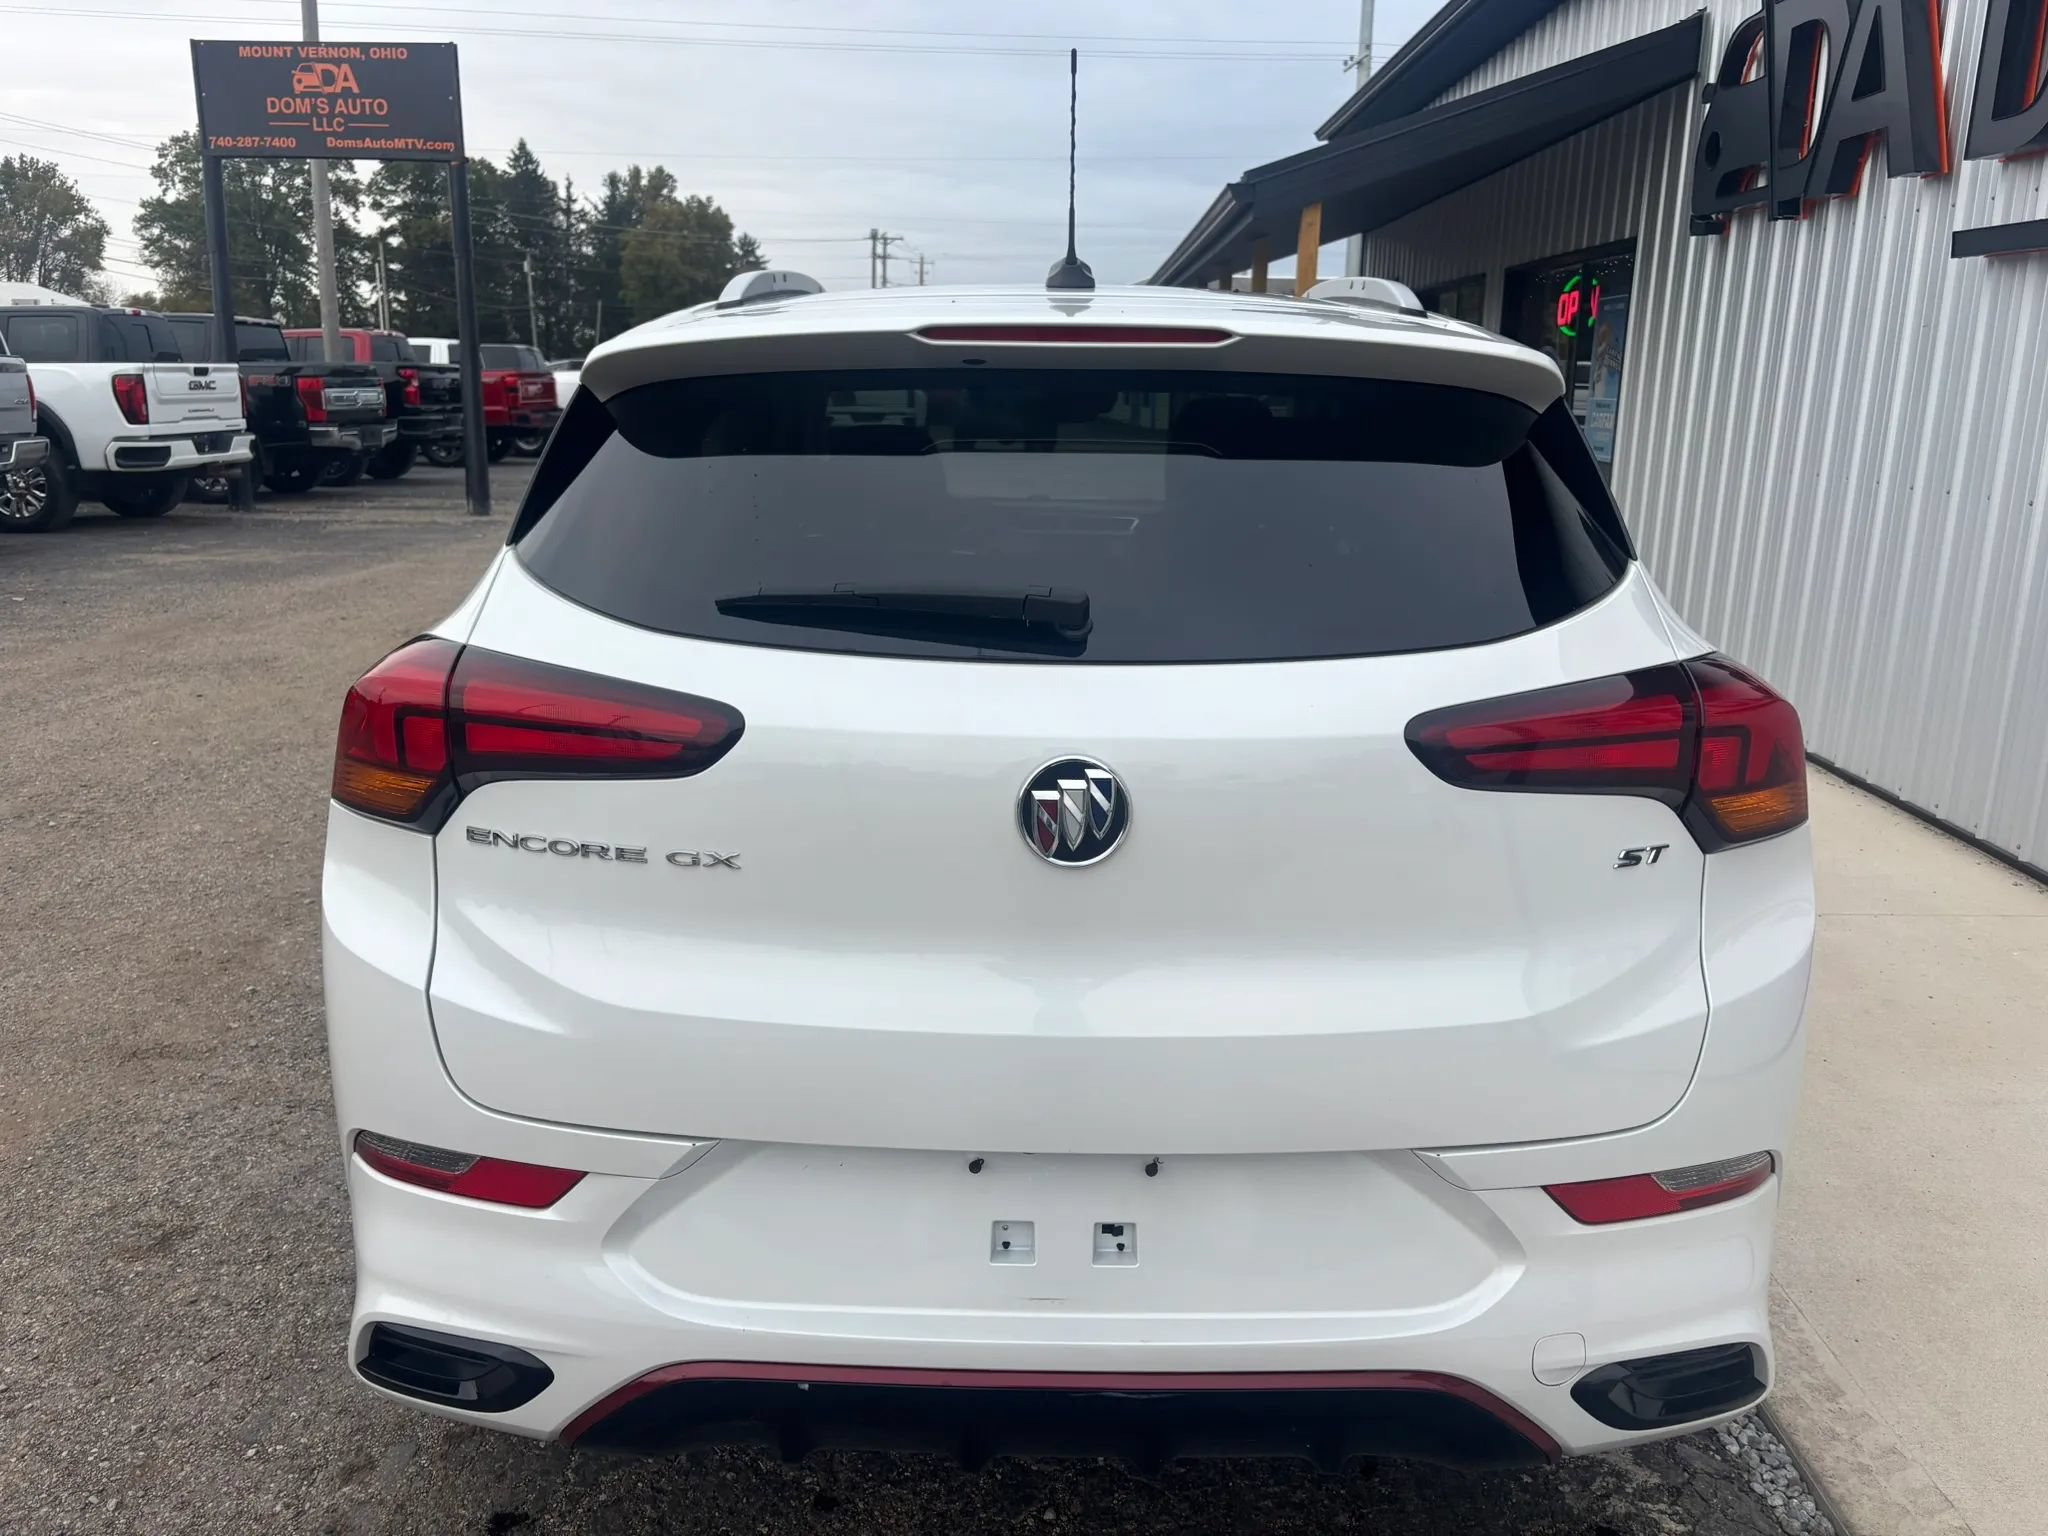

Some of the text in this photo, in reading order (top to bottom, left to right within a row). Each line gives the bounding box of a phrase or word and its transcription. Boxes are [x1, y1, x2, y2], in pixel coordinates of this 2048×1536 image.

[238, 46, 408, 61] MOUNT VERNON, OHIO
[266, 97, 388, 116] DOM'S AUTO
[312, 117, 345, 132] LLC
[209, 136, 455, 152] 740-287-7400 DomsAutoMTV.com
[188, 380, 217, 391] GMC
[466, 825, 742, 870] ENCORE GX
[1613, 844, 1670, 870] ST
